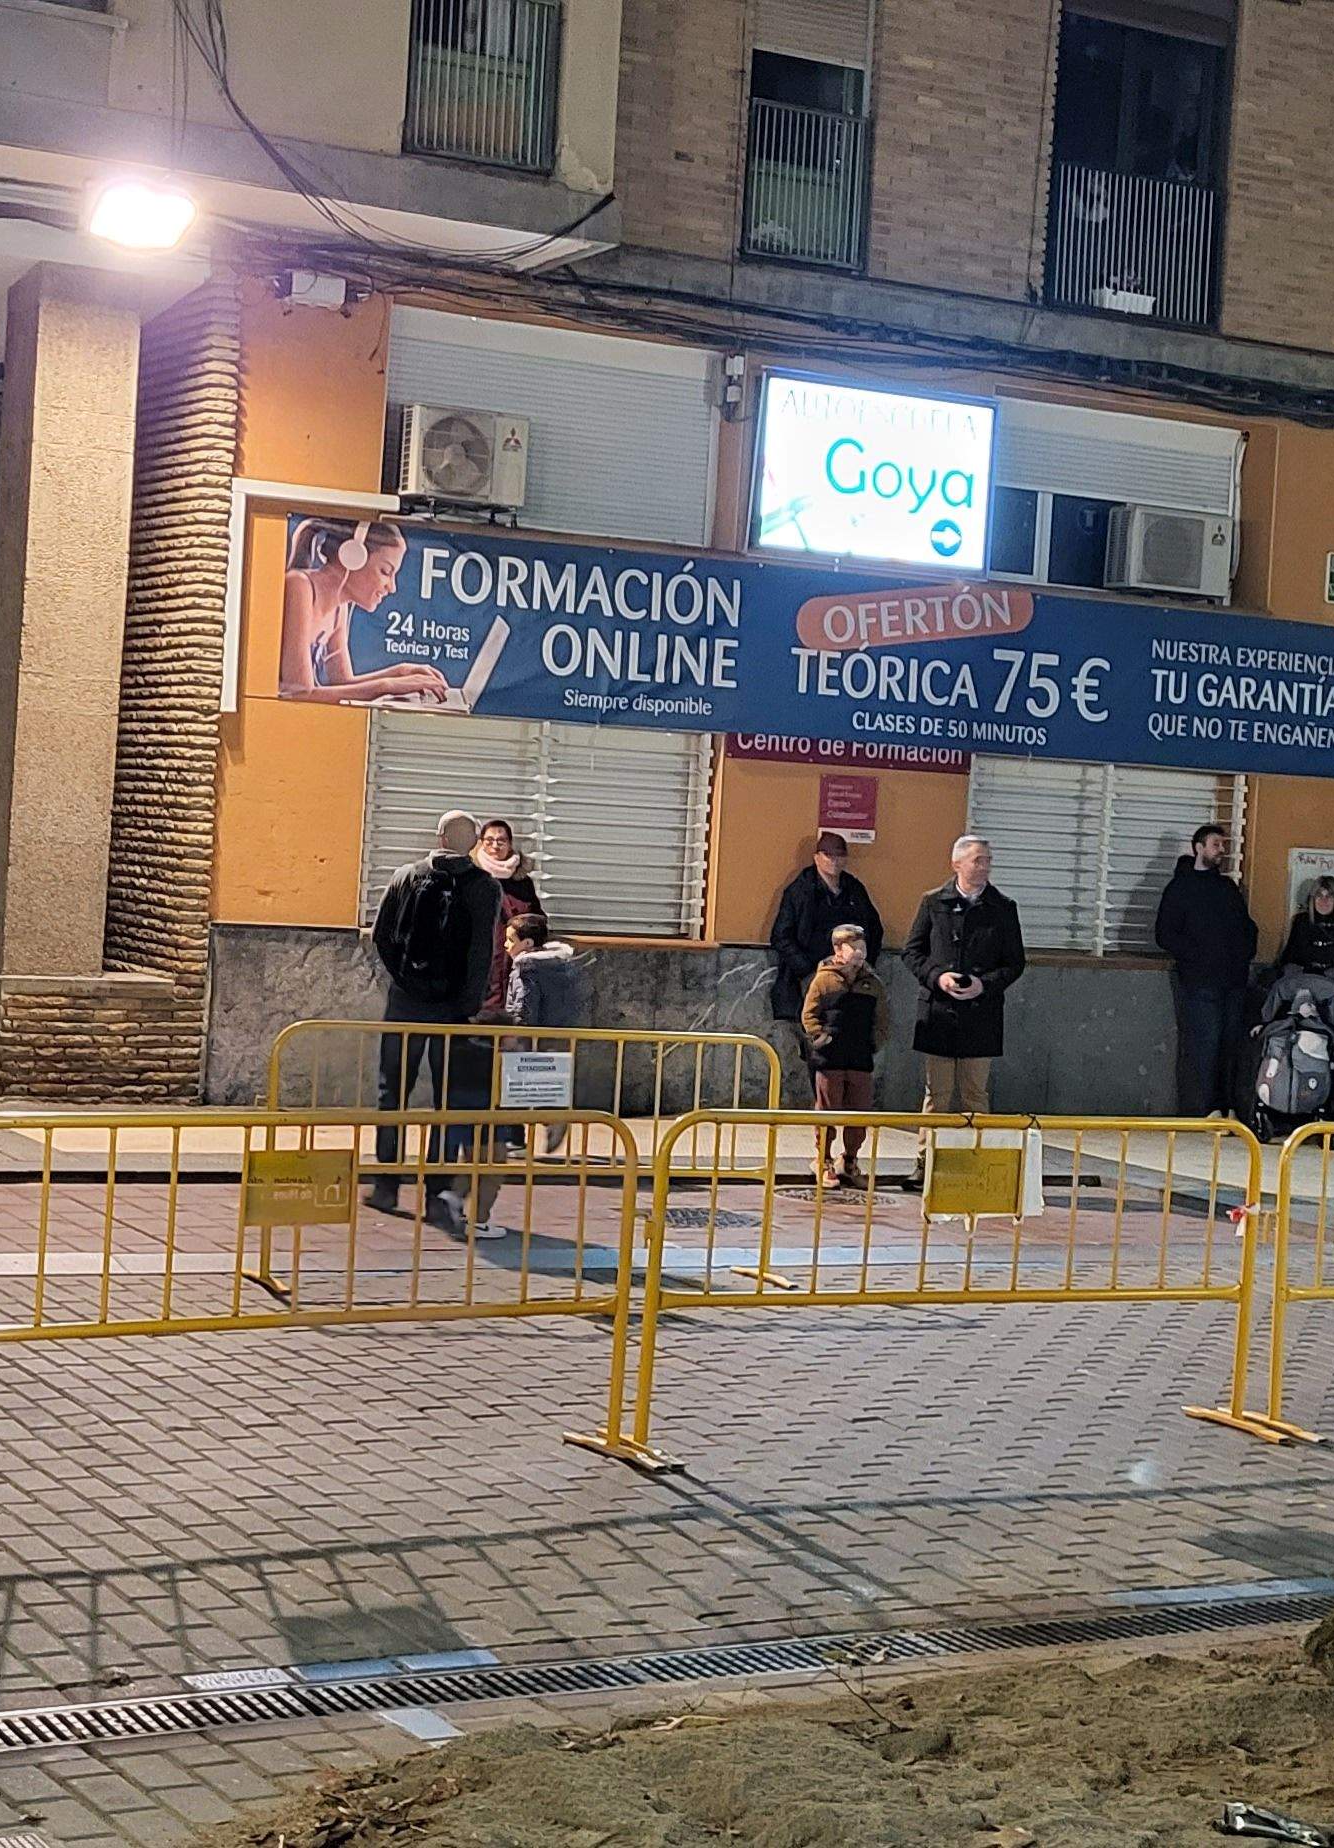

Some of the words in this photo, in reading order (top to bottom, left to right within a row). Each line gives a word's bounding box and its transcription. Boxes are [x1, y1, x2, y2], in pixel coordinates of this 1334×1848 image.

[826, 437, 973, 513] Goya
[420, 547, 741, 628] FORMACIÓN
[386, 612, 415, 636] 24
[422, 620, 470, 642] Horas
[823, 587, 1011, 643] OFERTÓN
[385, 637, 429, 657] Teórica
[432, 645, 441, 660] y
[444, 643, 469, 660] Test
[542, 624, 739, 688] ONLINE
[1151, 638, 1232, 666] NUESTRA
[791, 641, 979, 709] TEÓRICA
[993, 648, 1060, 718] 75
[1150, 669, 1188, 704] TU
[564, 688, 628, 714] Siempre
[632, 696, 713, 716] disponible
[737, 732, 811, 753] Centro
[852, 710, 915, 735] CLASES
[920, 717, 942, 736] DE
[947, 719, 968, 739] 50
[972, 723, 1047, 746] MINUTOS
[1148, 712, 1188, 741] QUE
[1192, 717, 1223, 740] NO
[1228, 719, 1248, 742] TE
